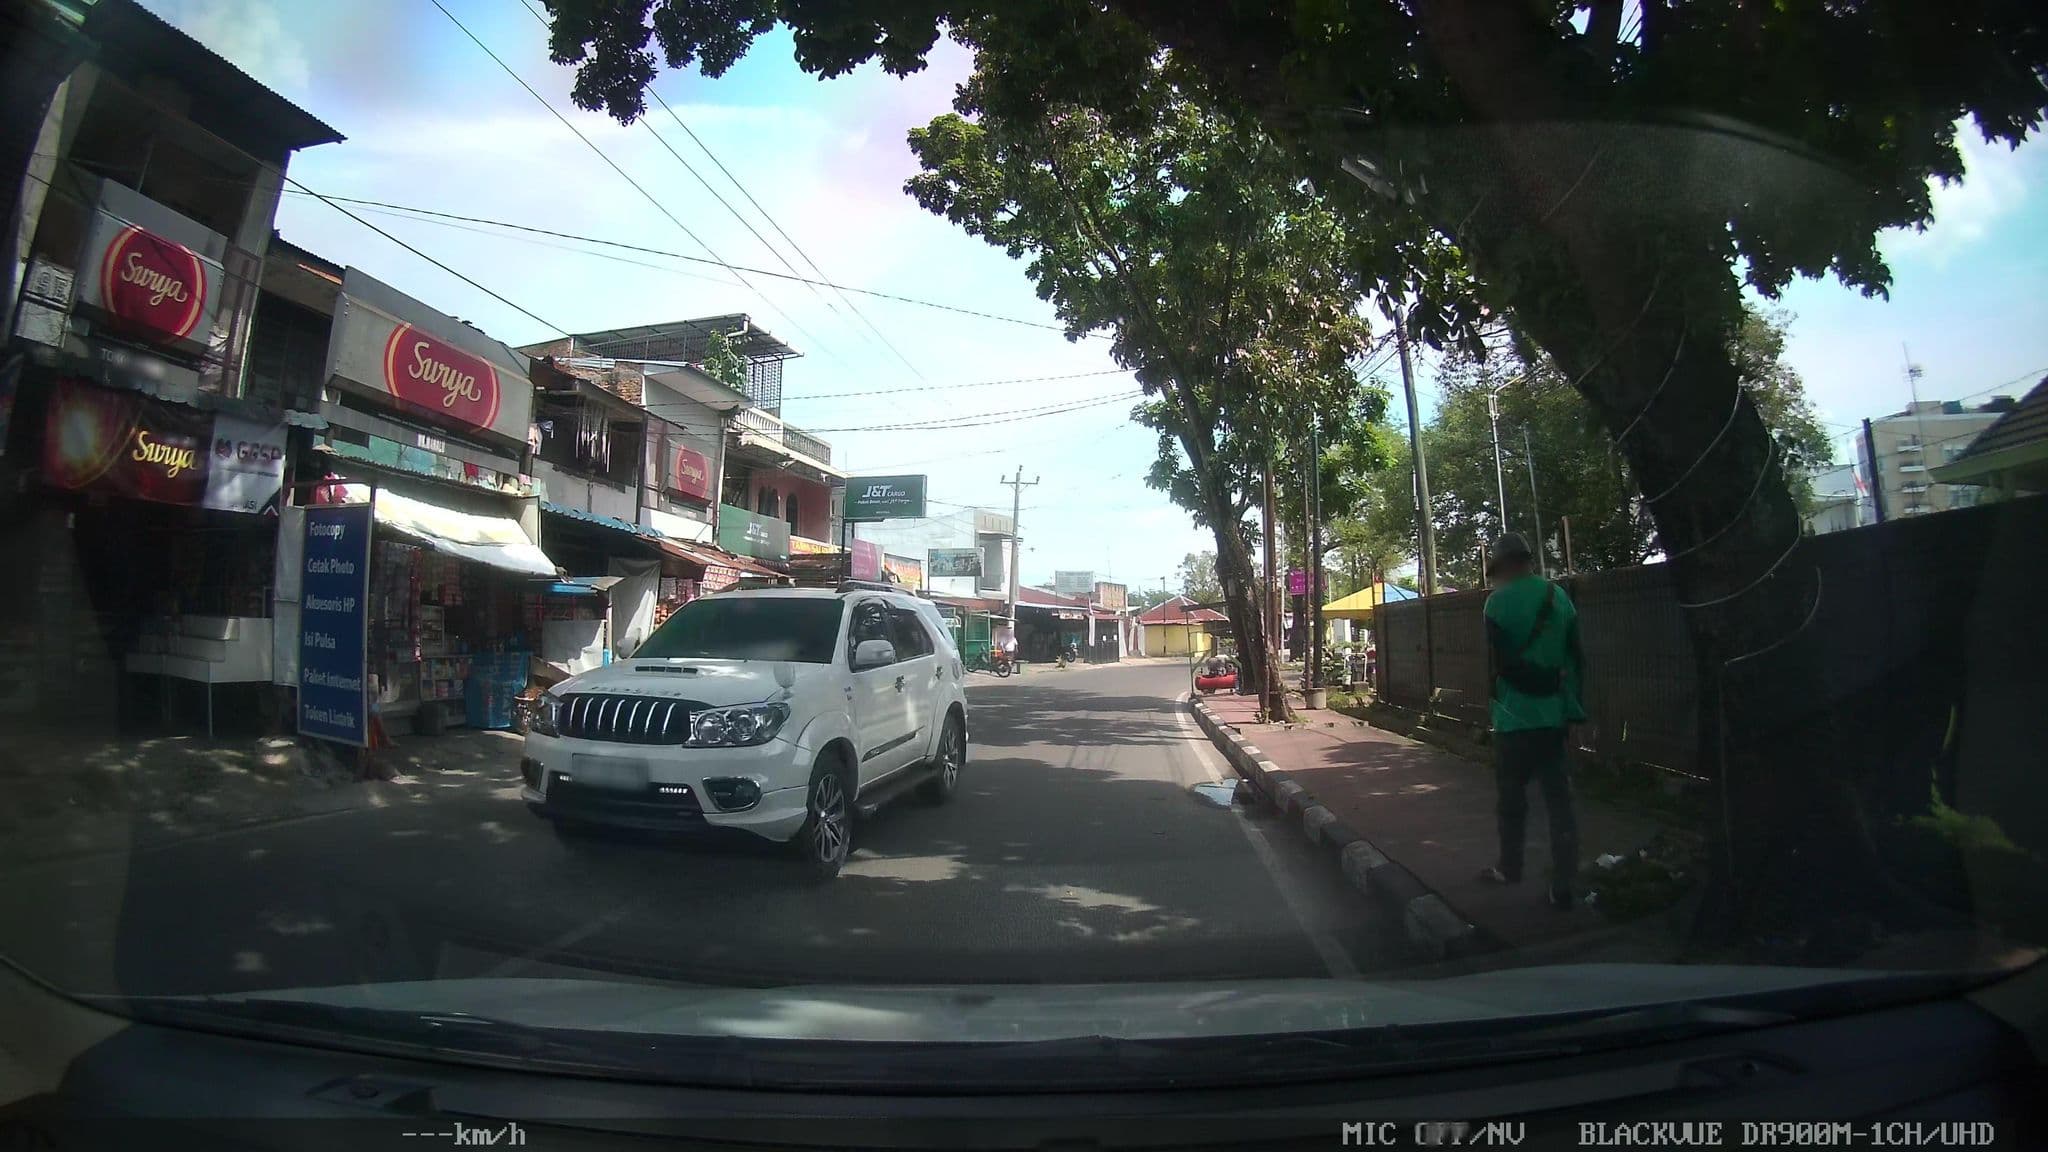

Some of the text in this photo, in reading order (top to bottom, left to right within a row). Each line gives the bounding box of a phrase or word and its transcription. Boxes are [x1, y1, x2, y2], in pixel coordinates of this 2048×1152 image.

[121, 252, 188, 306] Surya
[408, 341, 482, 407] Surya
[132, 431, 197, 478] Surya
[862, 484, 894, 498] J&T
[310, 521, 346, 540] Fotocopy
[307, 558, 355, 575] Cetak Photo
[343, 597, 355, 613] HP
[304, 631, 336, 649] Isi Pulsa
